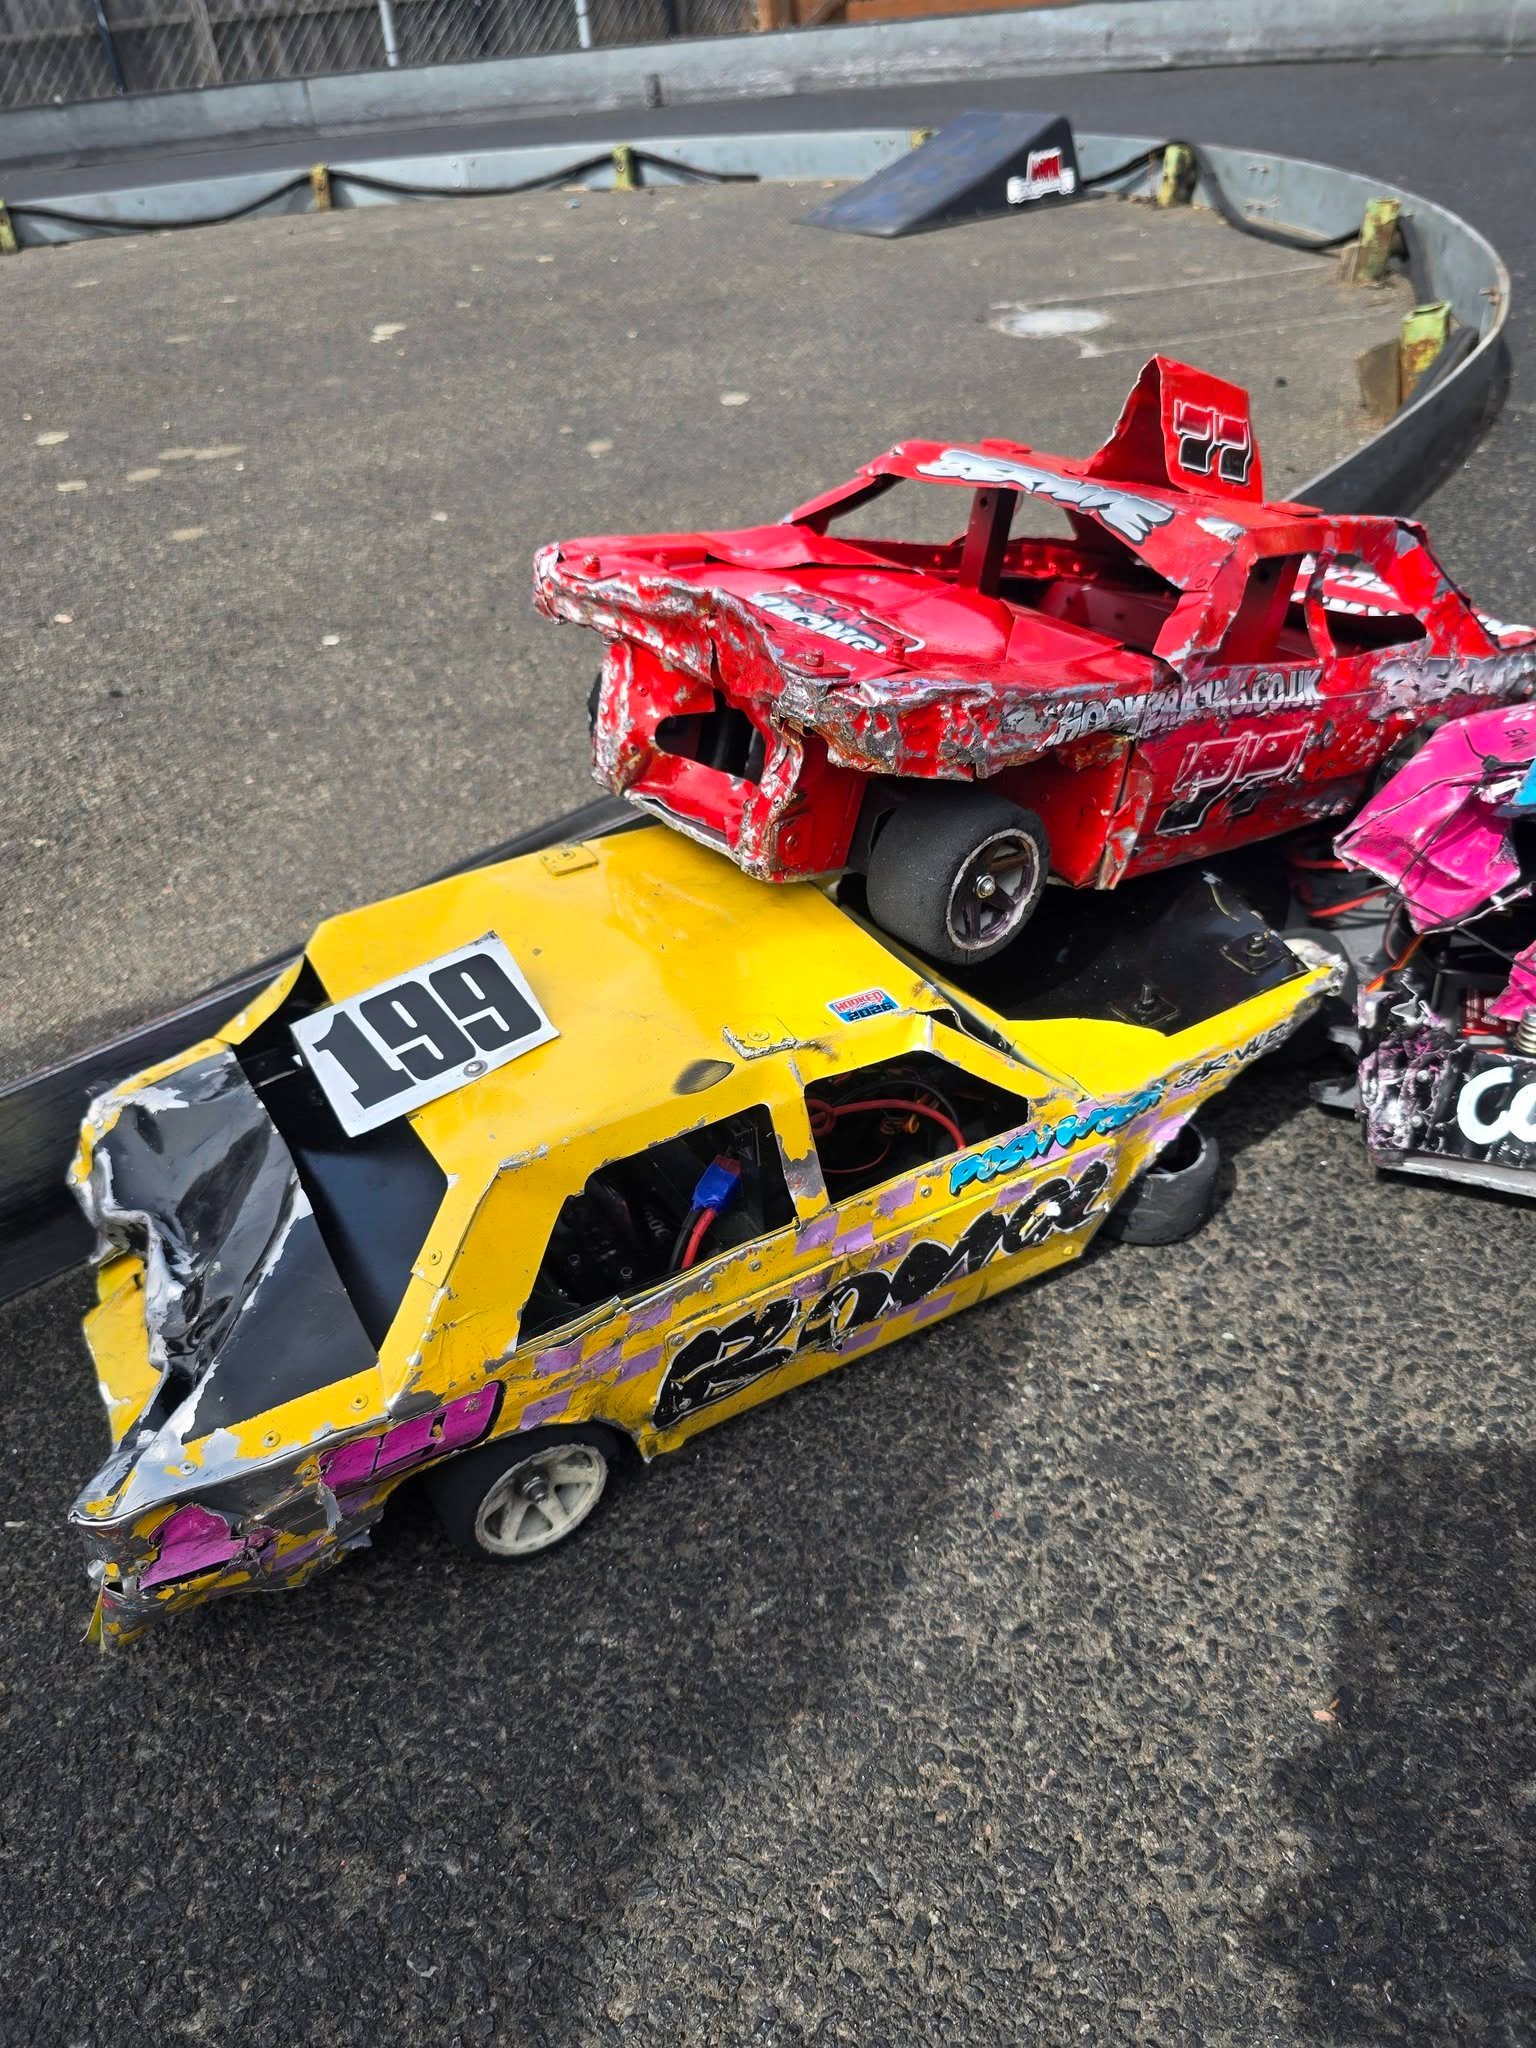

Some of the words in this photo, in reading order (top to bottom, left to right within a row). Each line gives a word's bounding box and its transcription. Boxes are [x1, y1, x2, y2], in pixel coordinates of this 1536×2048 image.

[1172, 398, 1254, 486] 77
[311, 952, 543, 1110] 199
[833, 990, 884, 1013] HOOKED
